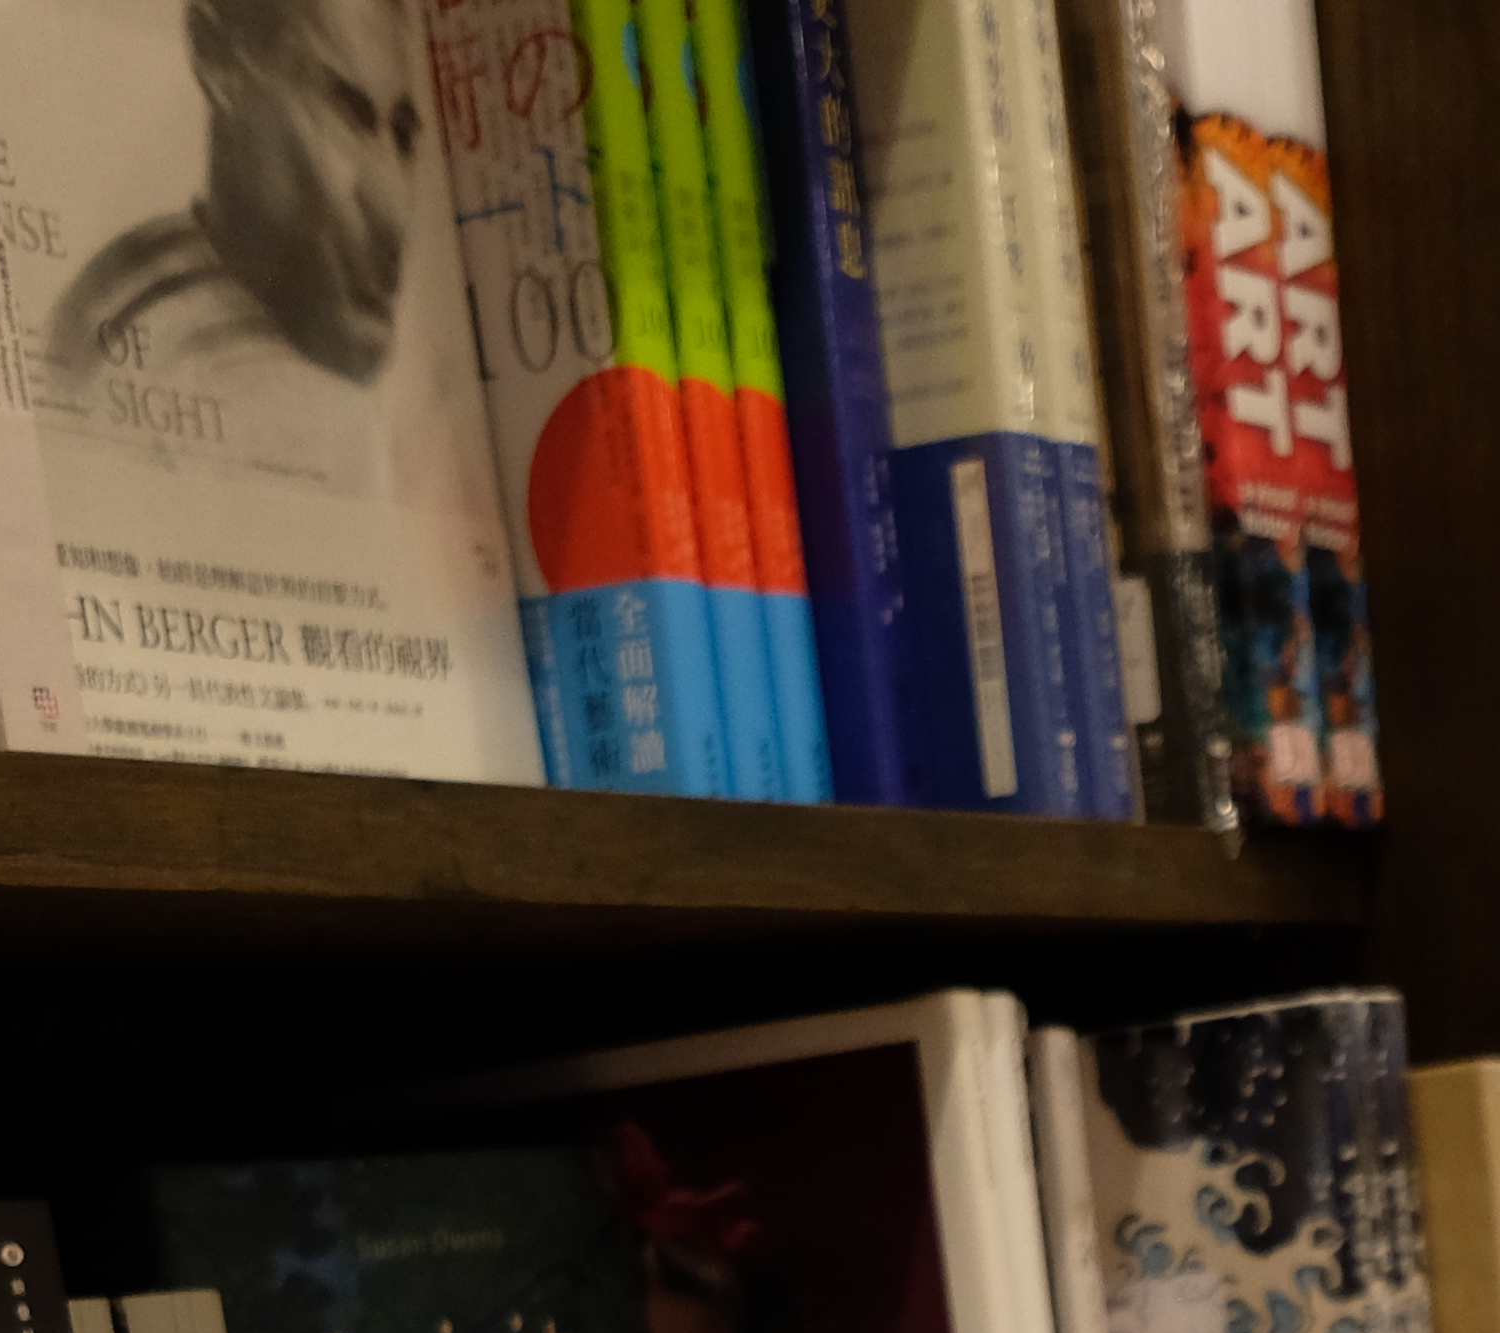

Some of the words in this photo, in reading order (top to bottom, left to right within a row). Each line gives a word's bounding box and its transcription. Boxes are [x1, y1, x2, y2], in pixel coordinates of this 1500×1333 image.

[1202, 145, 1298, 458] ART
[1266, 170, 1354, 472] ART
[107, 388, 226, 443] SIGHT
[136, 603, 291, 668] BERGER
